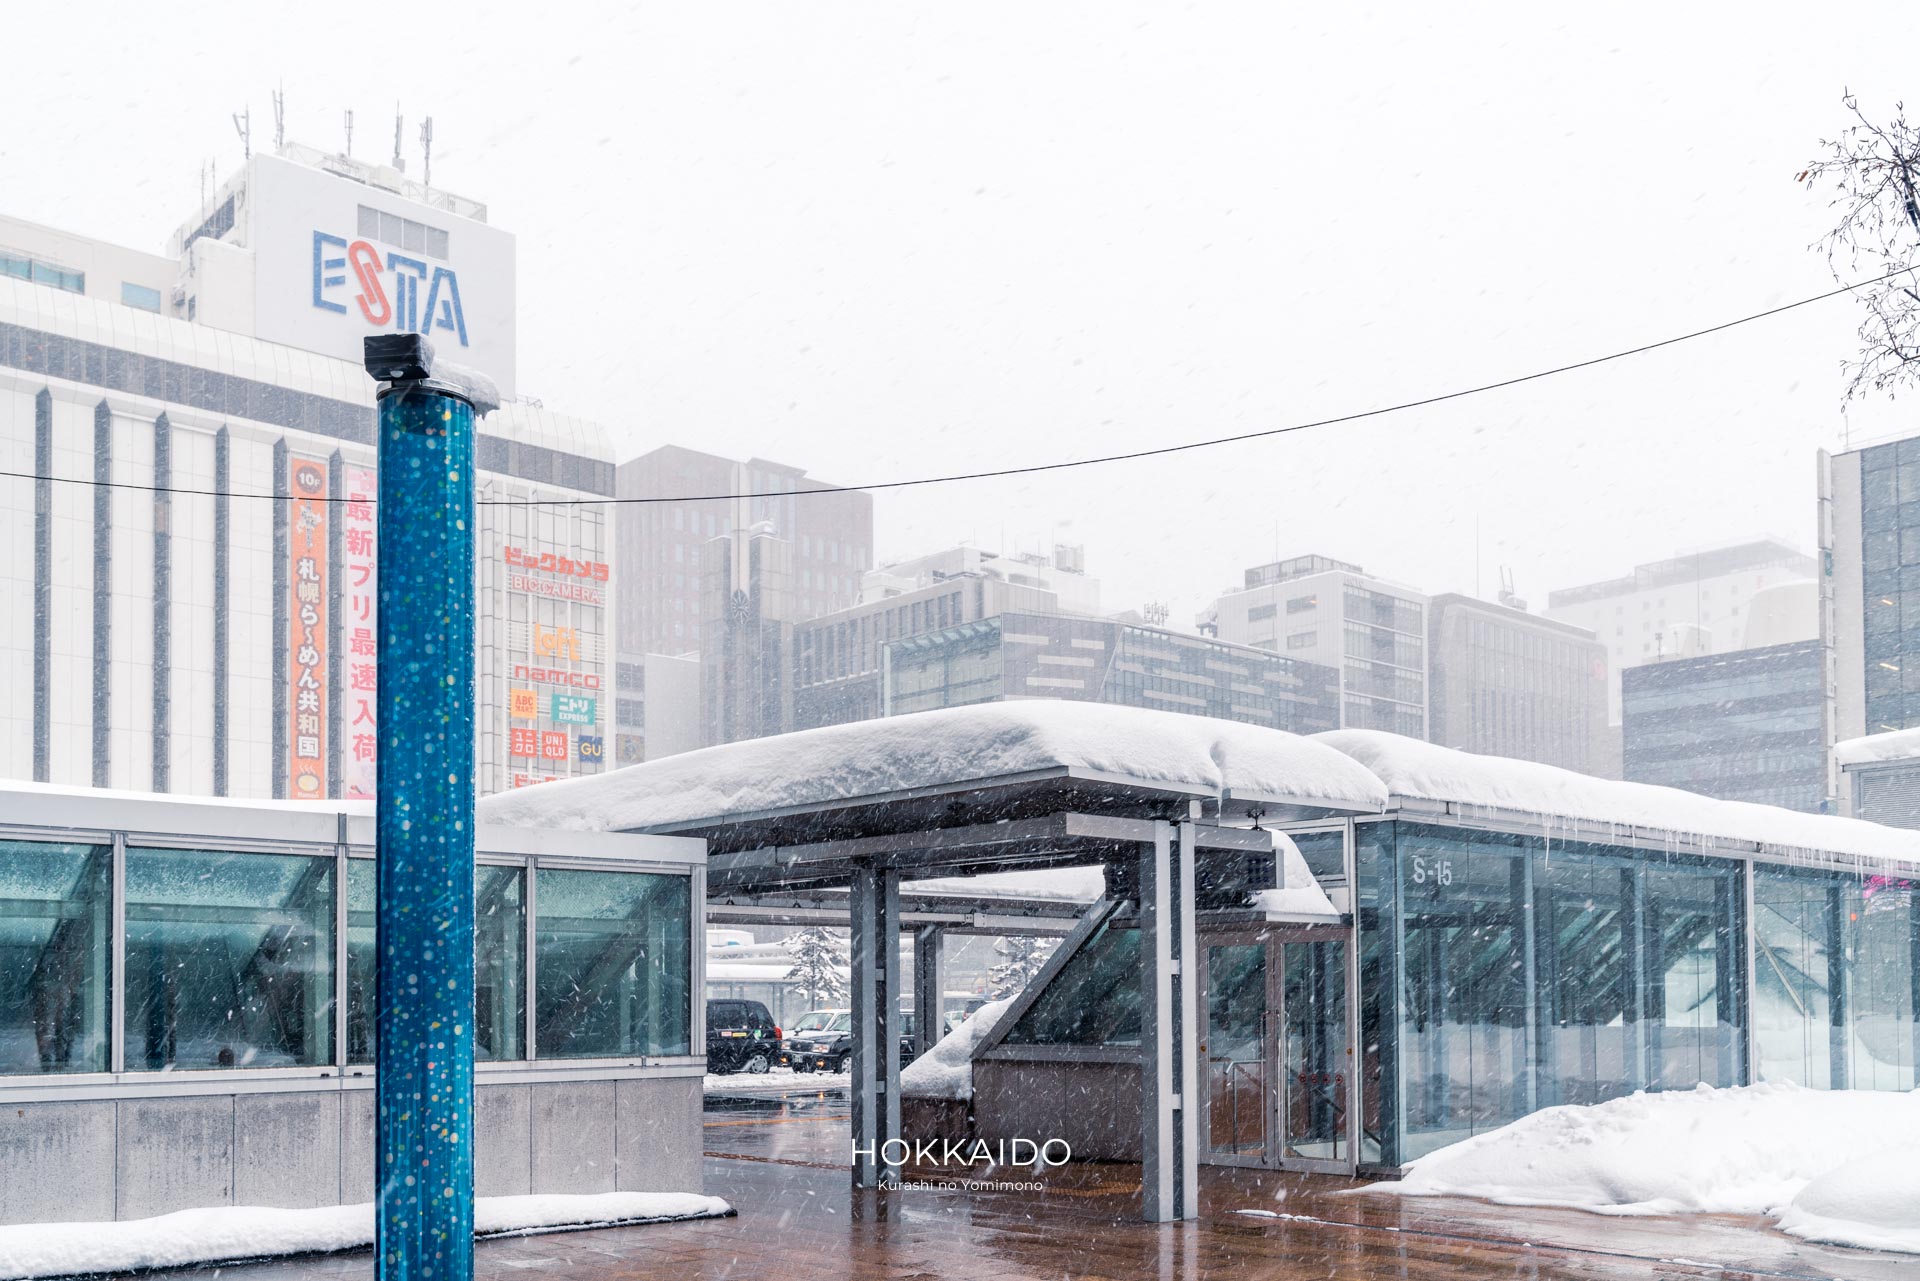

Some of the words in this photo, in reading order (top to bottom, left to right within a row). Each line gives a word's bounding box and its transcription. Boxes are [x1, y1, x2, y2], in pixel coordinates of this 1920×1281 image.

[313, 230, 469, 347] ESTA
[299, 472, 320, 487] 10F
[504, 545, 609, 582] ビックカメラ
[511, 575, 538, 592] BIC
[540, 580, 600, 603] CAMERA
[346, 492, 377, 763] 最新プリ最速入荷
[515, 665, 600, 689] namco
[516, 695, 533, 705] ABC
[559, 697, 588, 712] ニトリ
[559, 712, 588, 723] EXPRESS
[545, 735, 563, 746] UNI
[545, 745, 565, 757] QLO
[581, 742, 601, 756] GU
[1413, 857, 1452, 886] S-15
